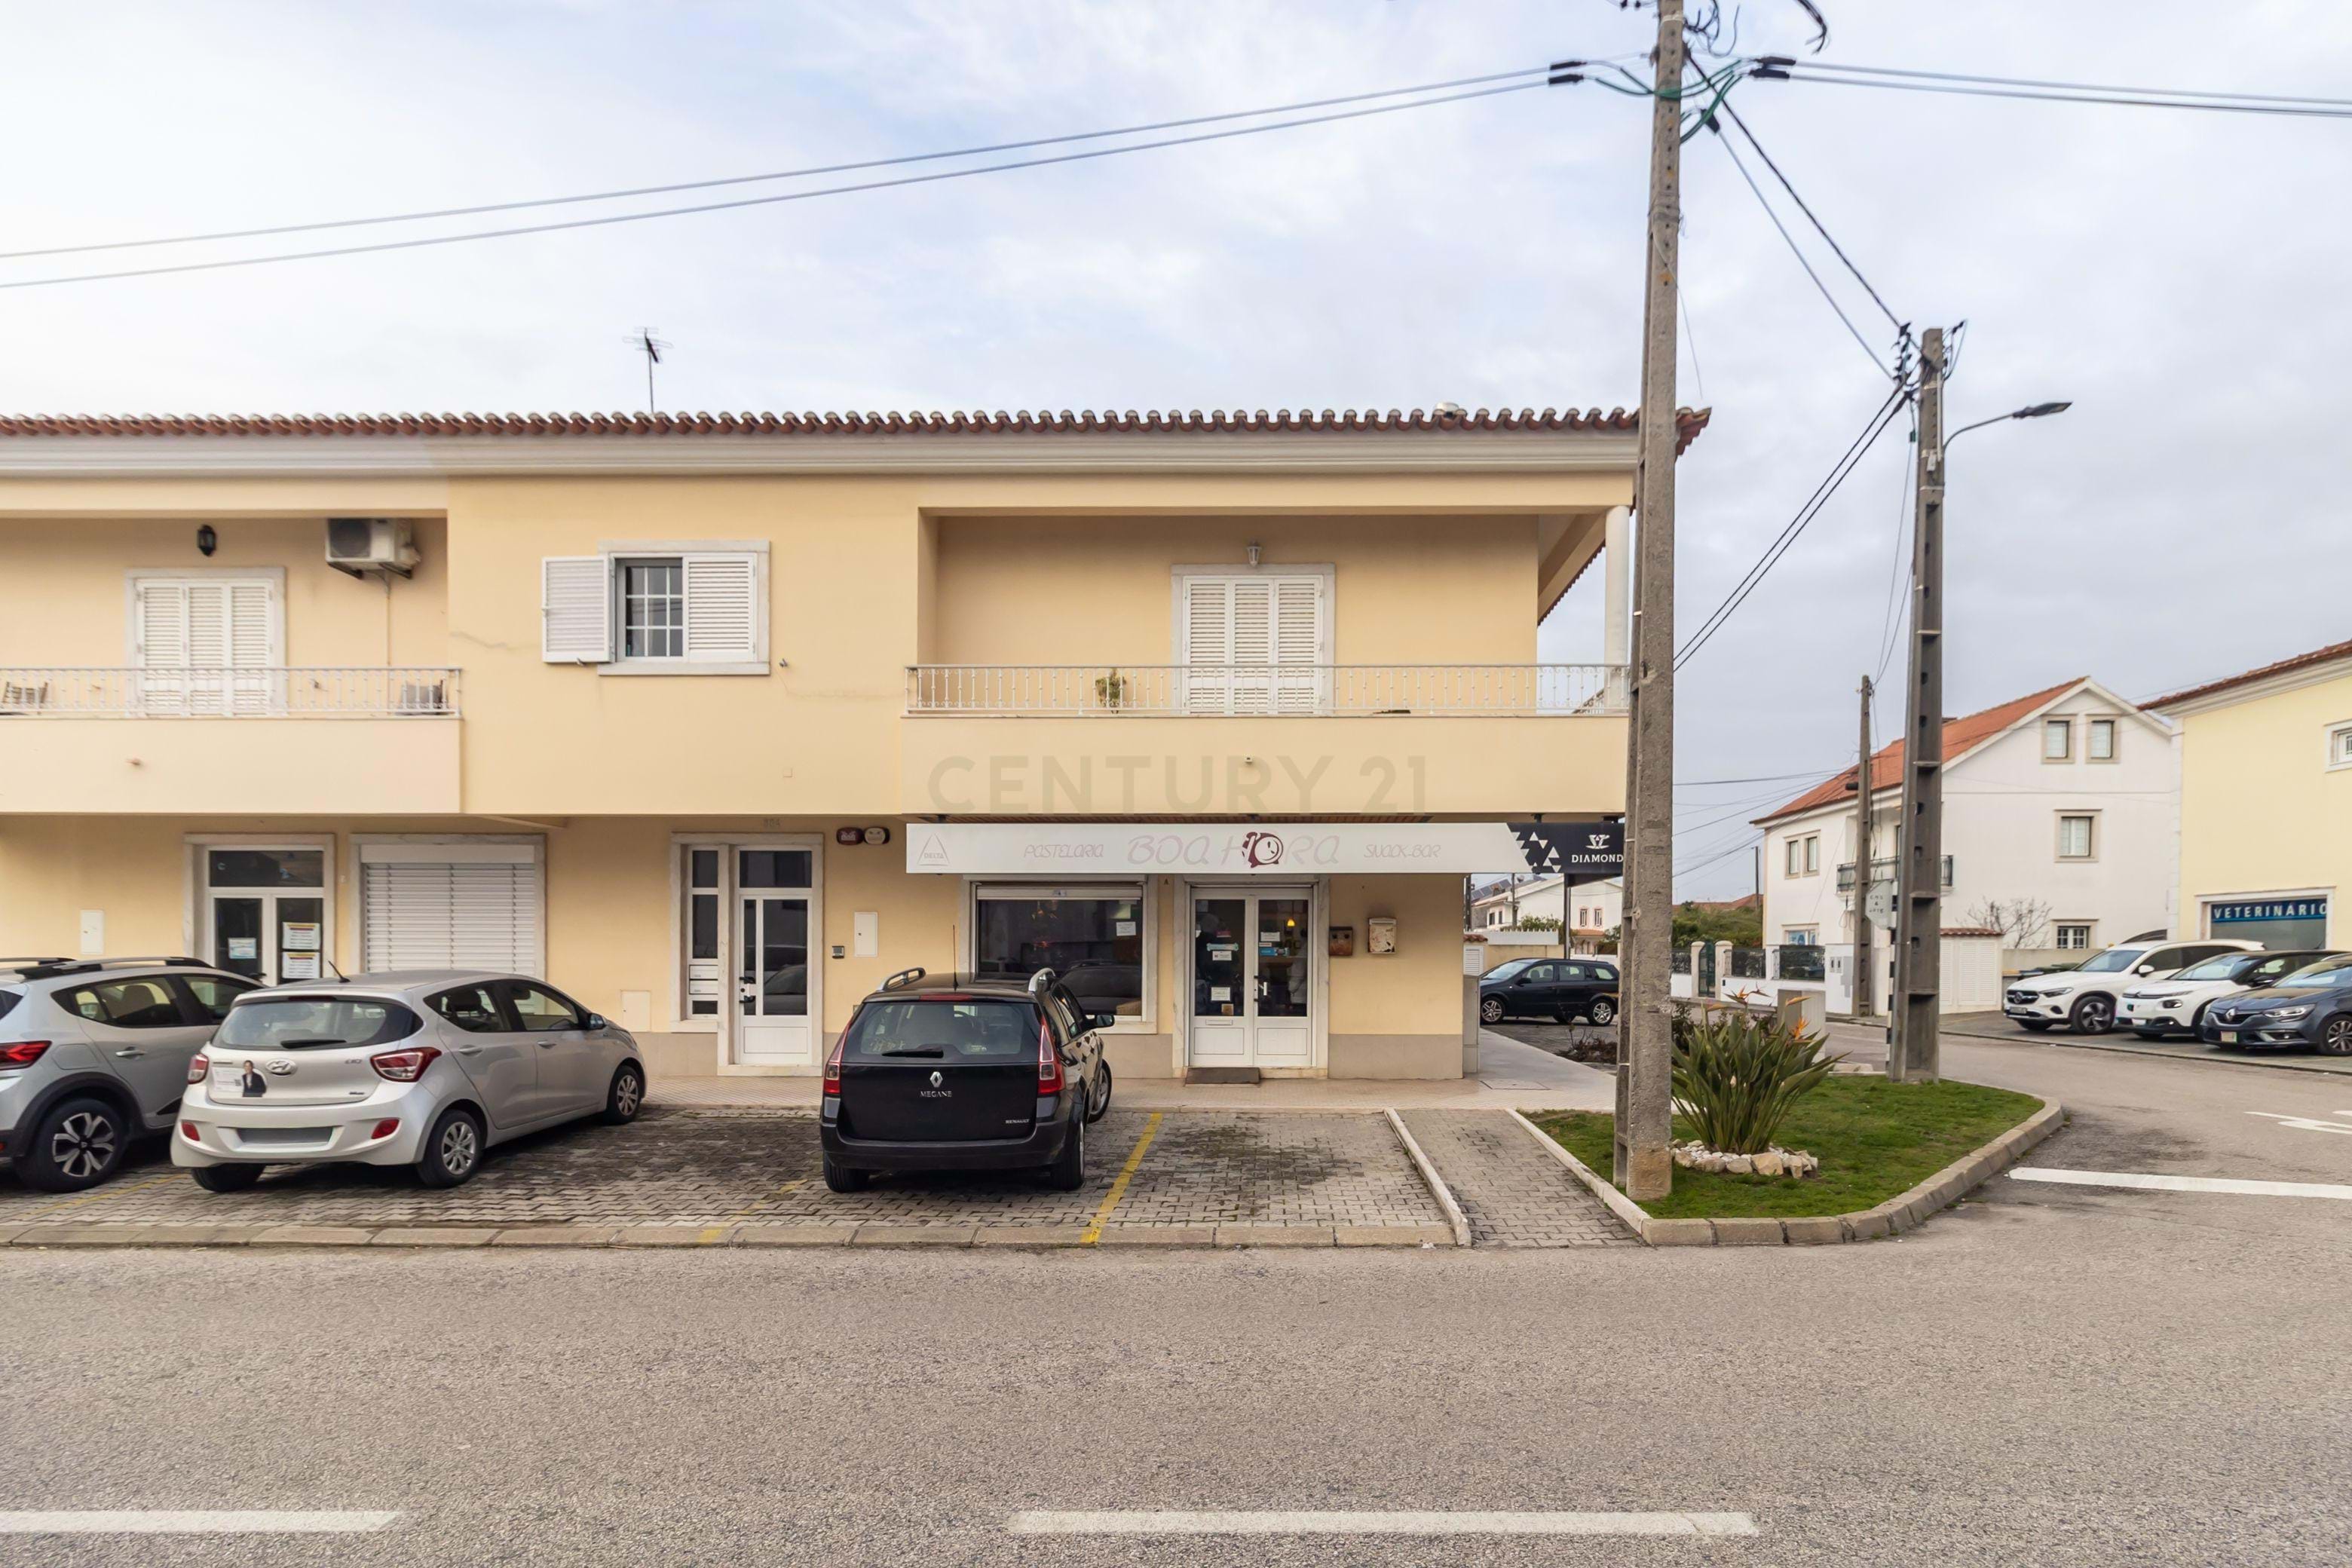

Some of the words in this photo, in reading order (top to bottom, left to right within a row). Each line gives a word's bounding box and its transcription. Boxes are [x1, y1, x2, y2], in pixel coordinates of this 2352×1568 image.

[1023, 844, 1104, 859] PASTELARIA
[1127, 835, 1211, 866] BOA
[1571, 853, 1624, 863] DIAMOND
